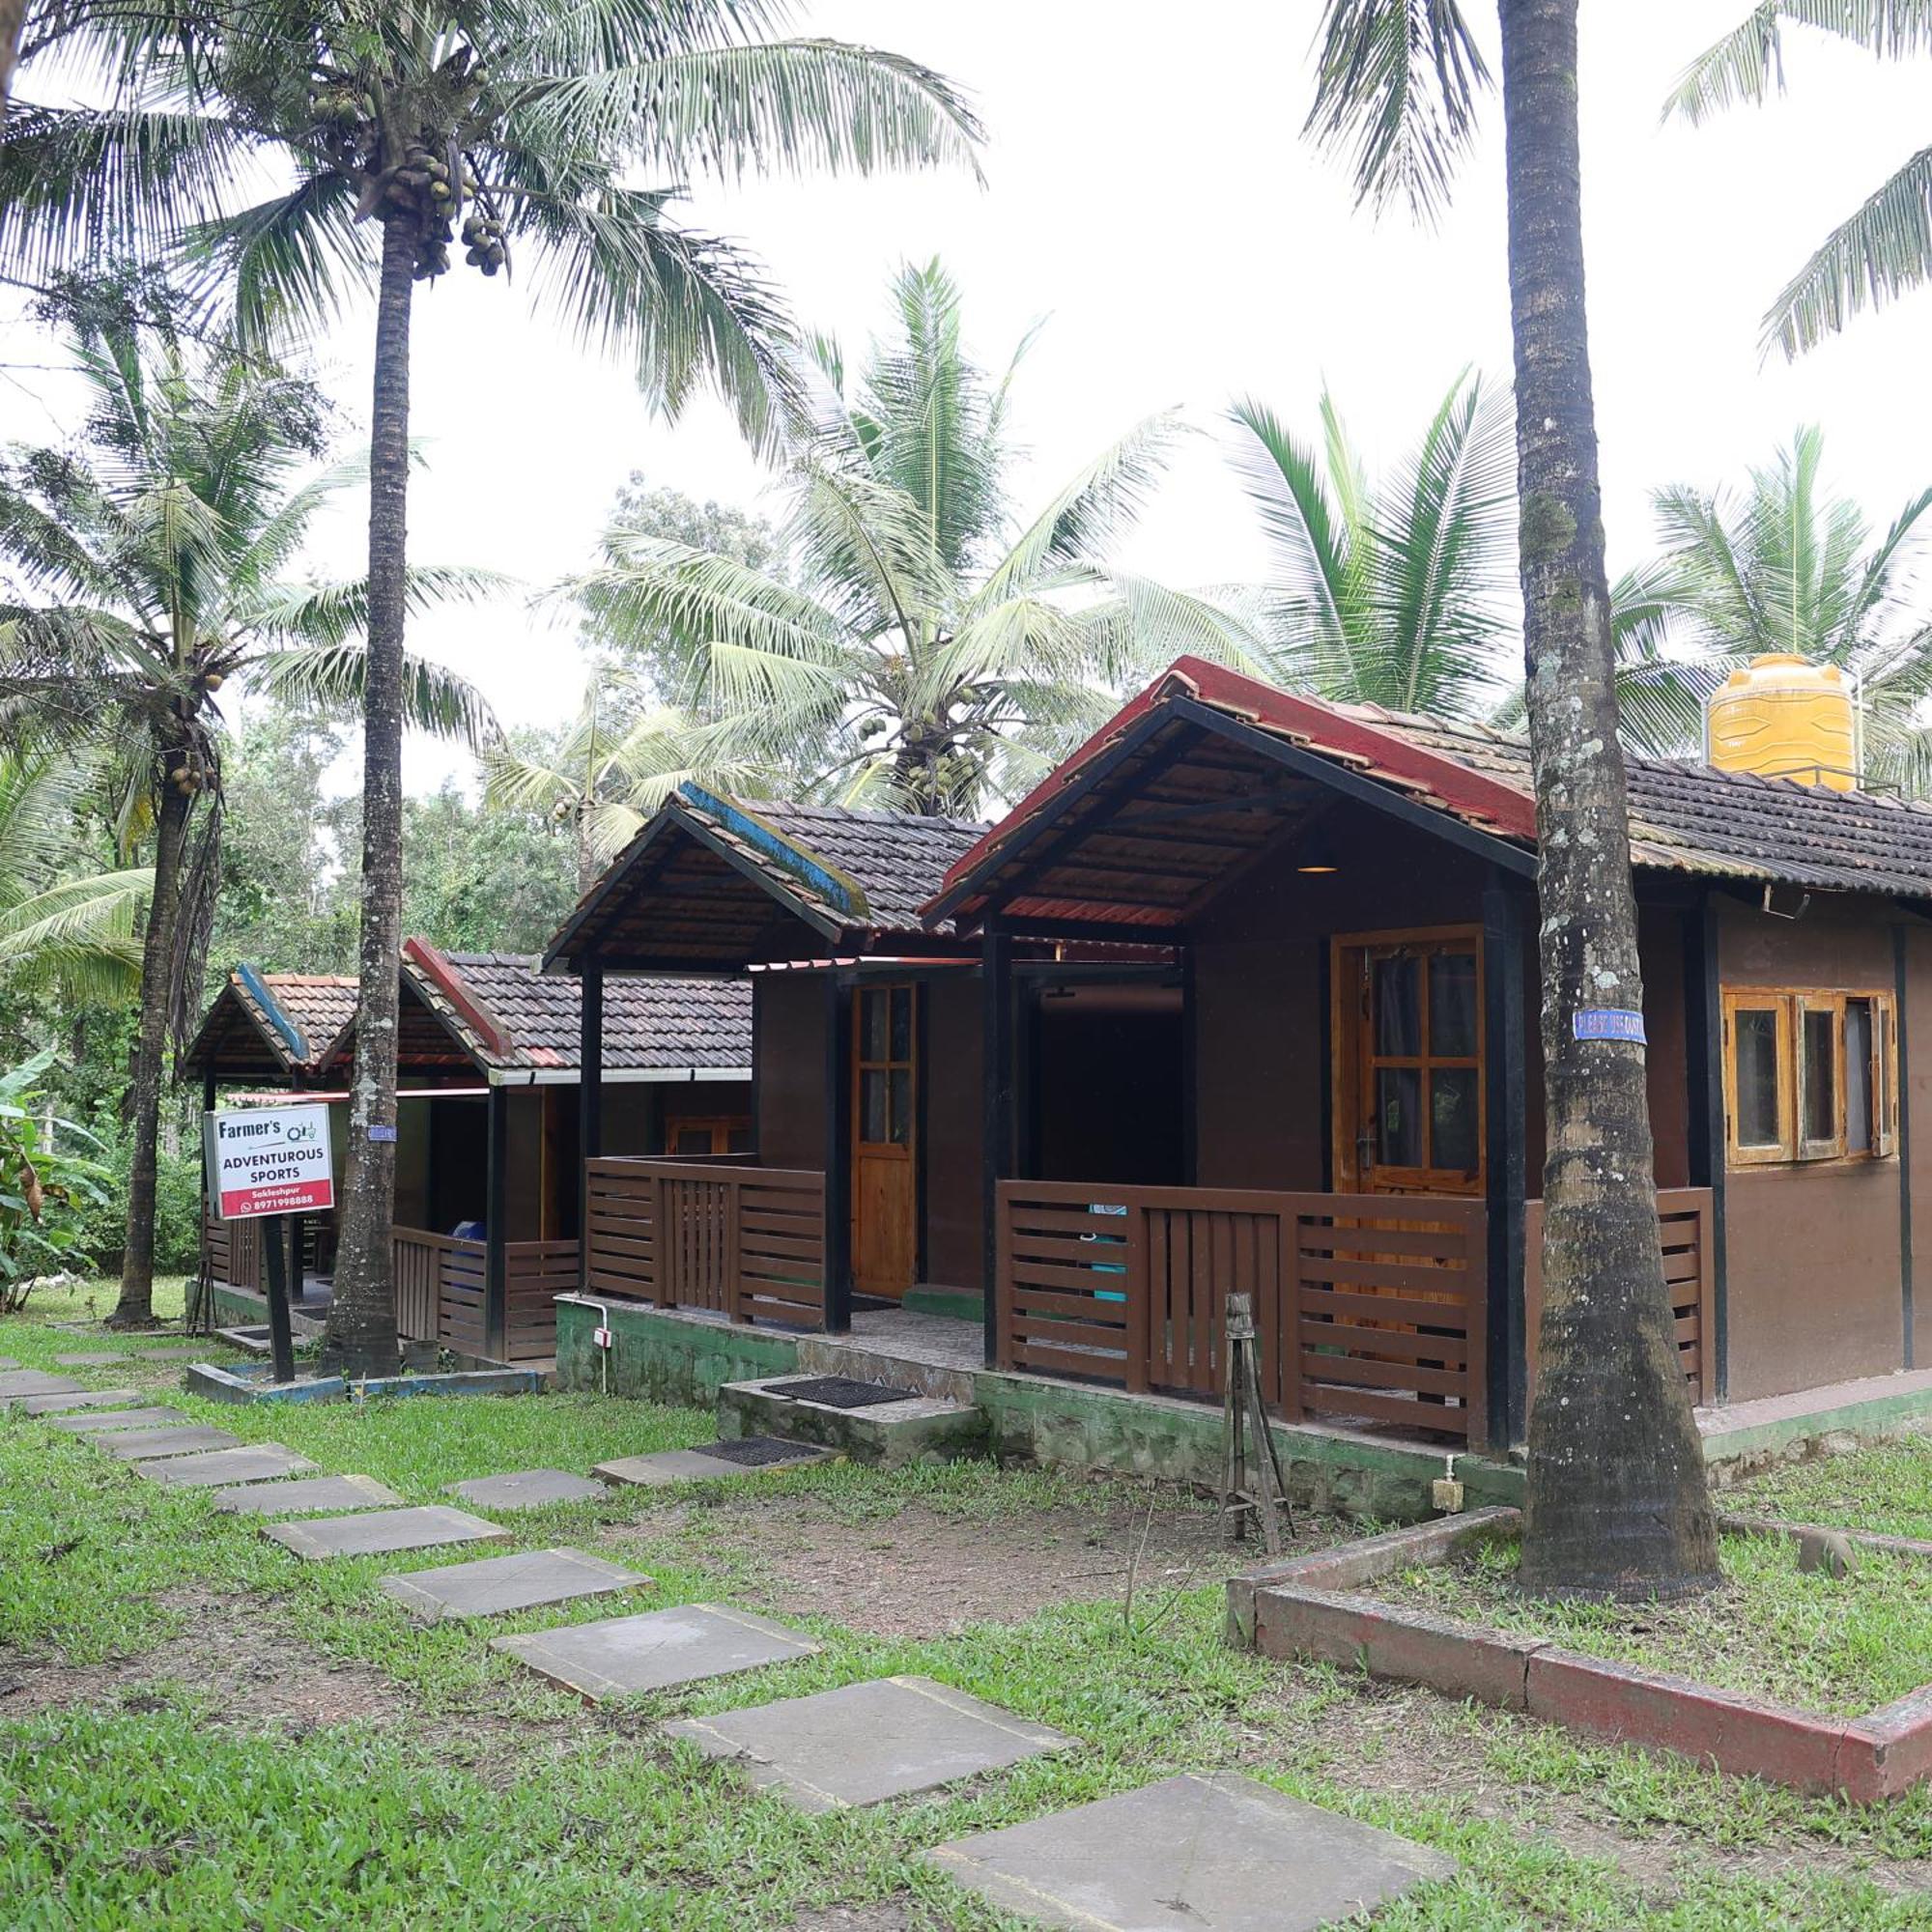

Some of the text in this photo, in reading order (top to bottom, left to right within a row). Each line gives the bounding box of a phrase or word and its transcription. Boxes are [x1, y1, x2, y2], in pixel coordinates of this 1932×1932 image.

[219, 1121, 281, 1139] Farmer's
[223, 1148, 324, 1170] ADVENTUROUS
[251, 1167, 300, 1182] SPORTS
[252, 1187, 300, 1200] Sakleshpur
[254, 1195, 313, 1210] 8971998888
